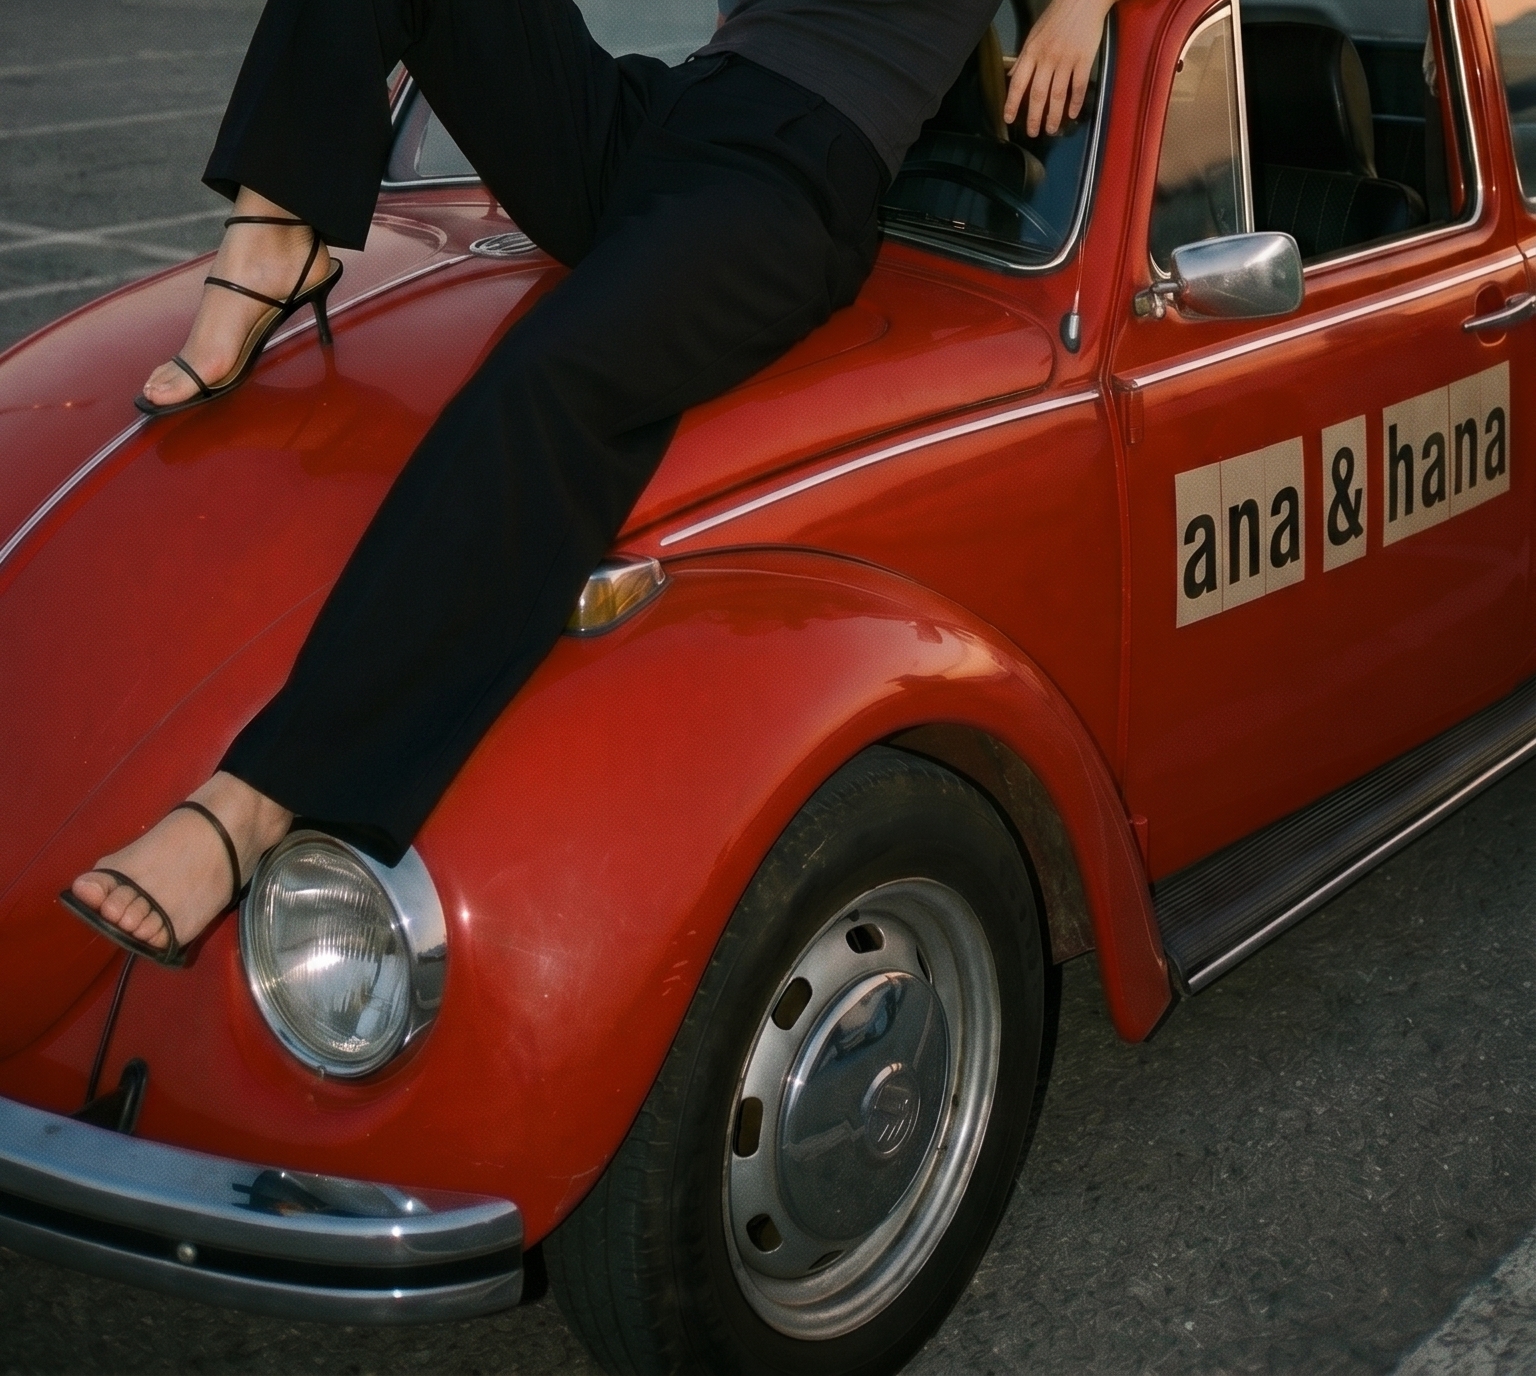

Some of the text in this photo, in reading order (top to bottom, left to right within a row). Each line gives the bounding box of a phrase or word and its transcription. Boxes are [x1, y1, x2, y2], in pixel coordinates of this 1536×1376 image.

[1183, 406, 1506, 599] ana & hana
